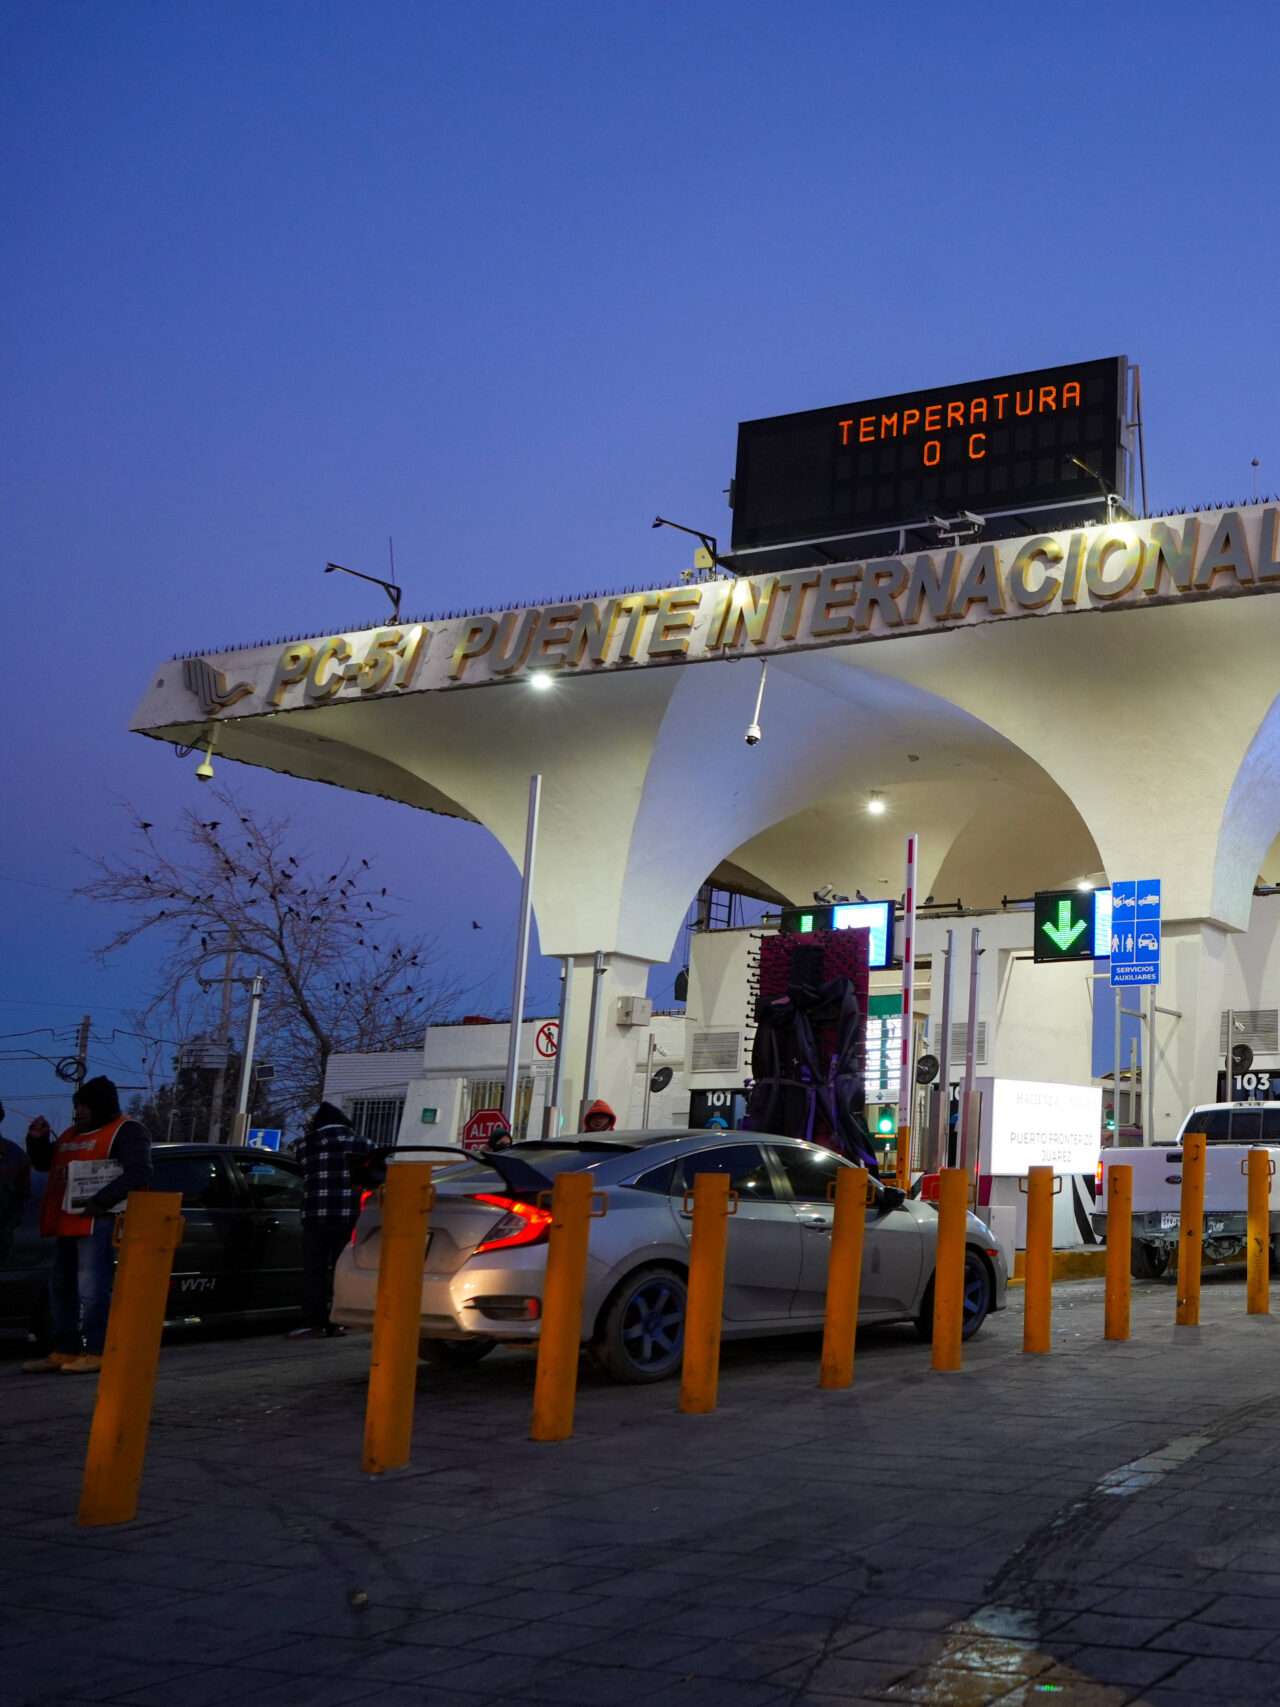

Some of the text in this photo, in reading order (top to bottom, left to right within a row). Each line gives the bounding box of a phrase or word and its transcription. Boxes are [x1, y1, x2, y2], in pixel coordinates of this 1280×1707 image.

[838, 381, 1082, 446] TEMPERATURA
[968, 432, 986, 460] C
[265, 624, 429, 706] PC-51
[448, 588, 702, 681] PUENTE
[1234, 1073, 1271, 1091] 103
[706, 1091, 731, 1106] 101
[1010, 1131, 1048, 1145] PUERTO
